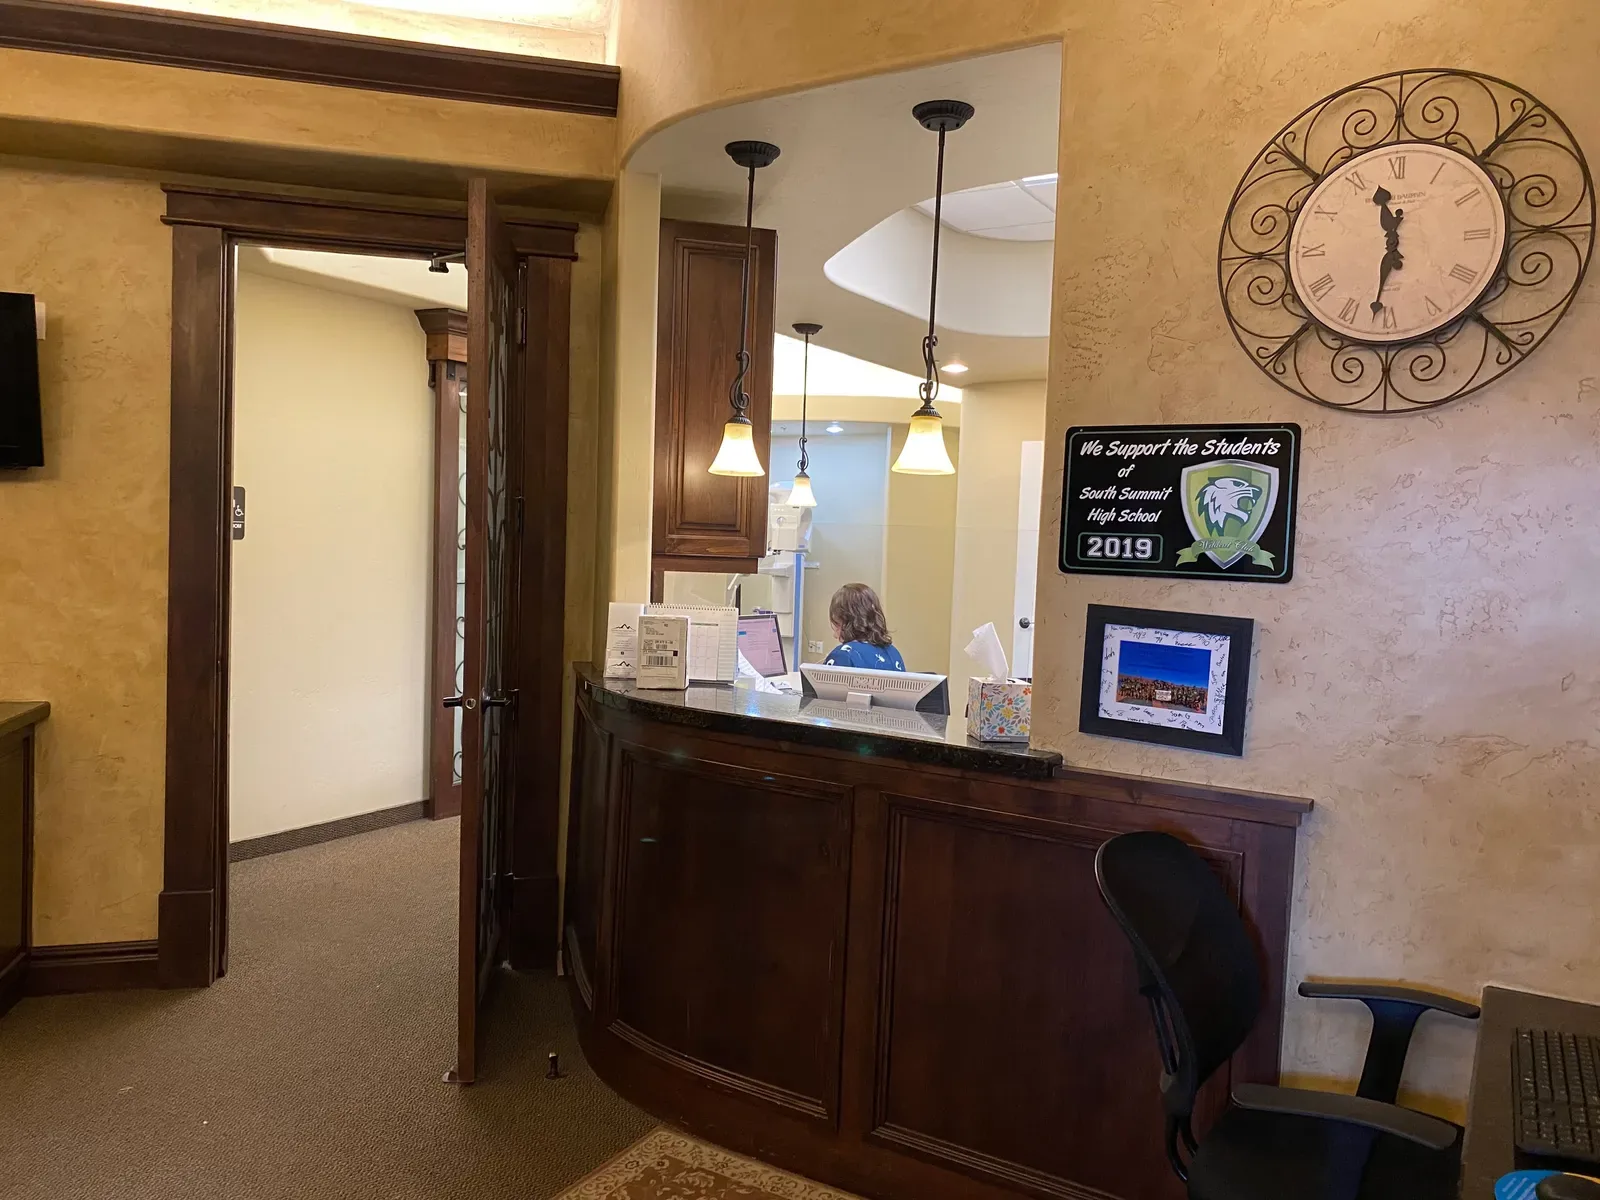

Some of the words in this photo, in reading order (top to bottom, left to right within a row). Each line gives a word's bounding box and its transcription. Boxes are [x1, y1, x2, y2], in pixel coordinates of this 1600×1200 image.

[1388, 156, 1406, 179] XII
[1345, 171, 1366, 196] XI
[1454, 188, 1480, 207] II
[1314, 205, 1338, 222] X
[1463, 228, 1491, 241] III
[1080, 440, 1103, 456] We
[1105, 438, 1171, 459] Support
[1172, 438, 1198, 455] the
[1201, 437, 1281, 456] Students
[1117, 464, 1135, 478] of
[1080, 486, 1116, 500] South
[1119, 486, 1173, 501] Summit
[1087, 508, 1116, 525] High
[1118, 508, 1161, 523] School
[1087, 536, 1153, 559] 2019
